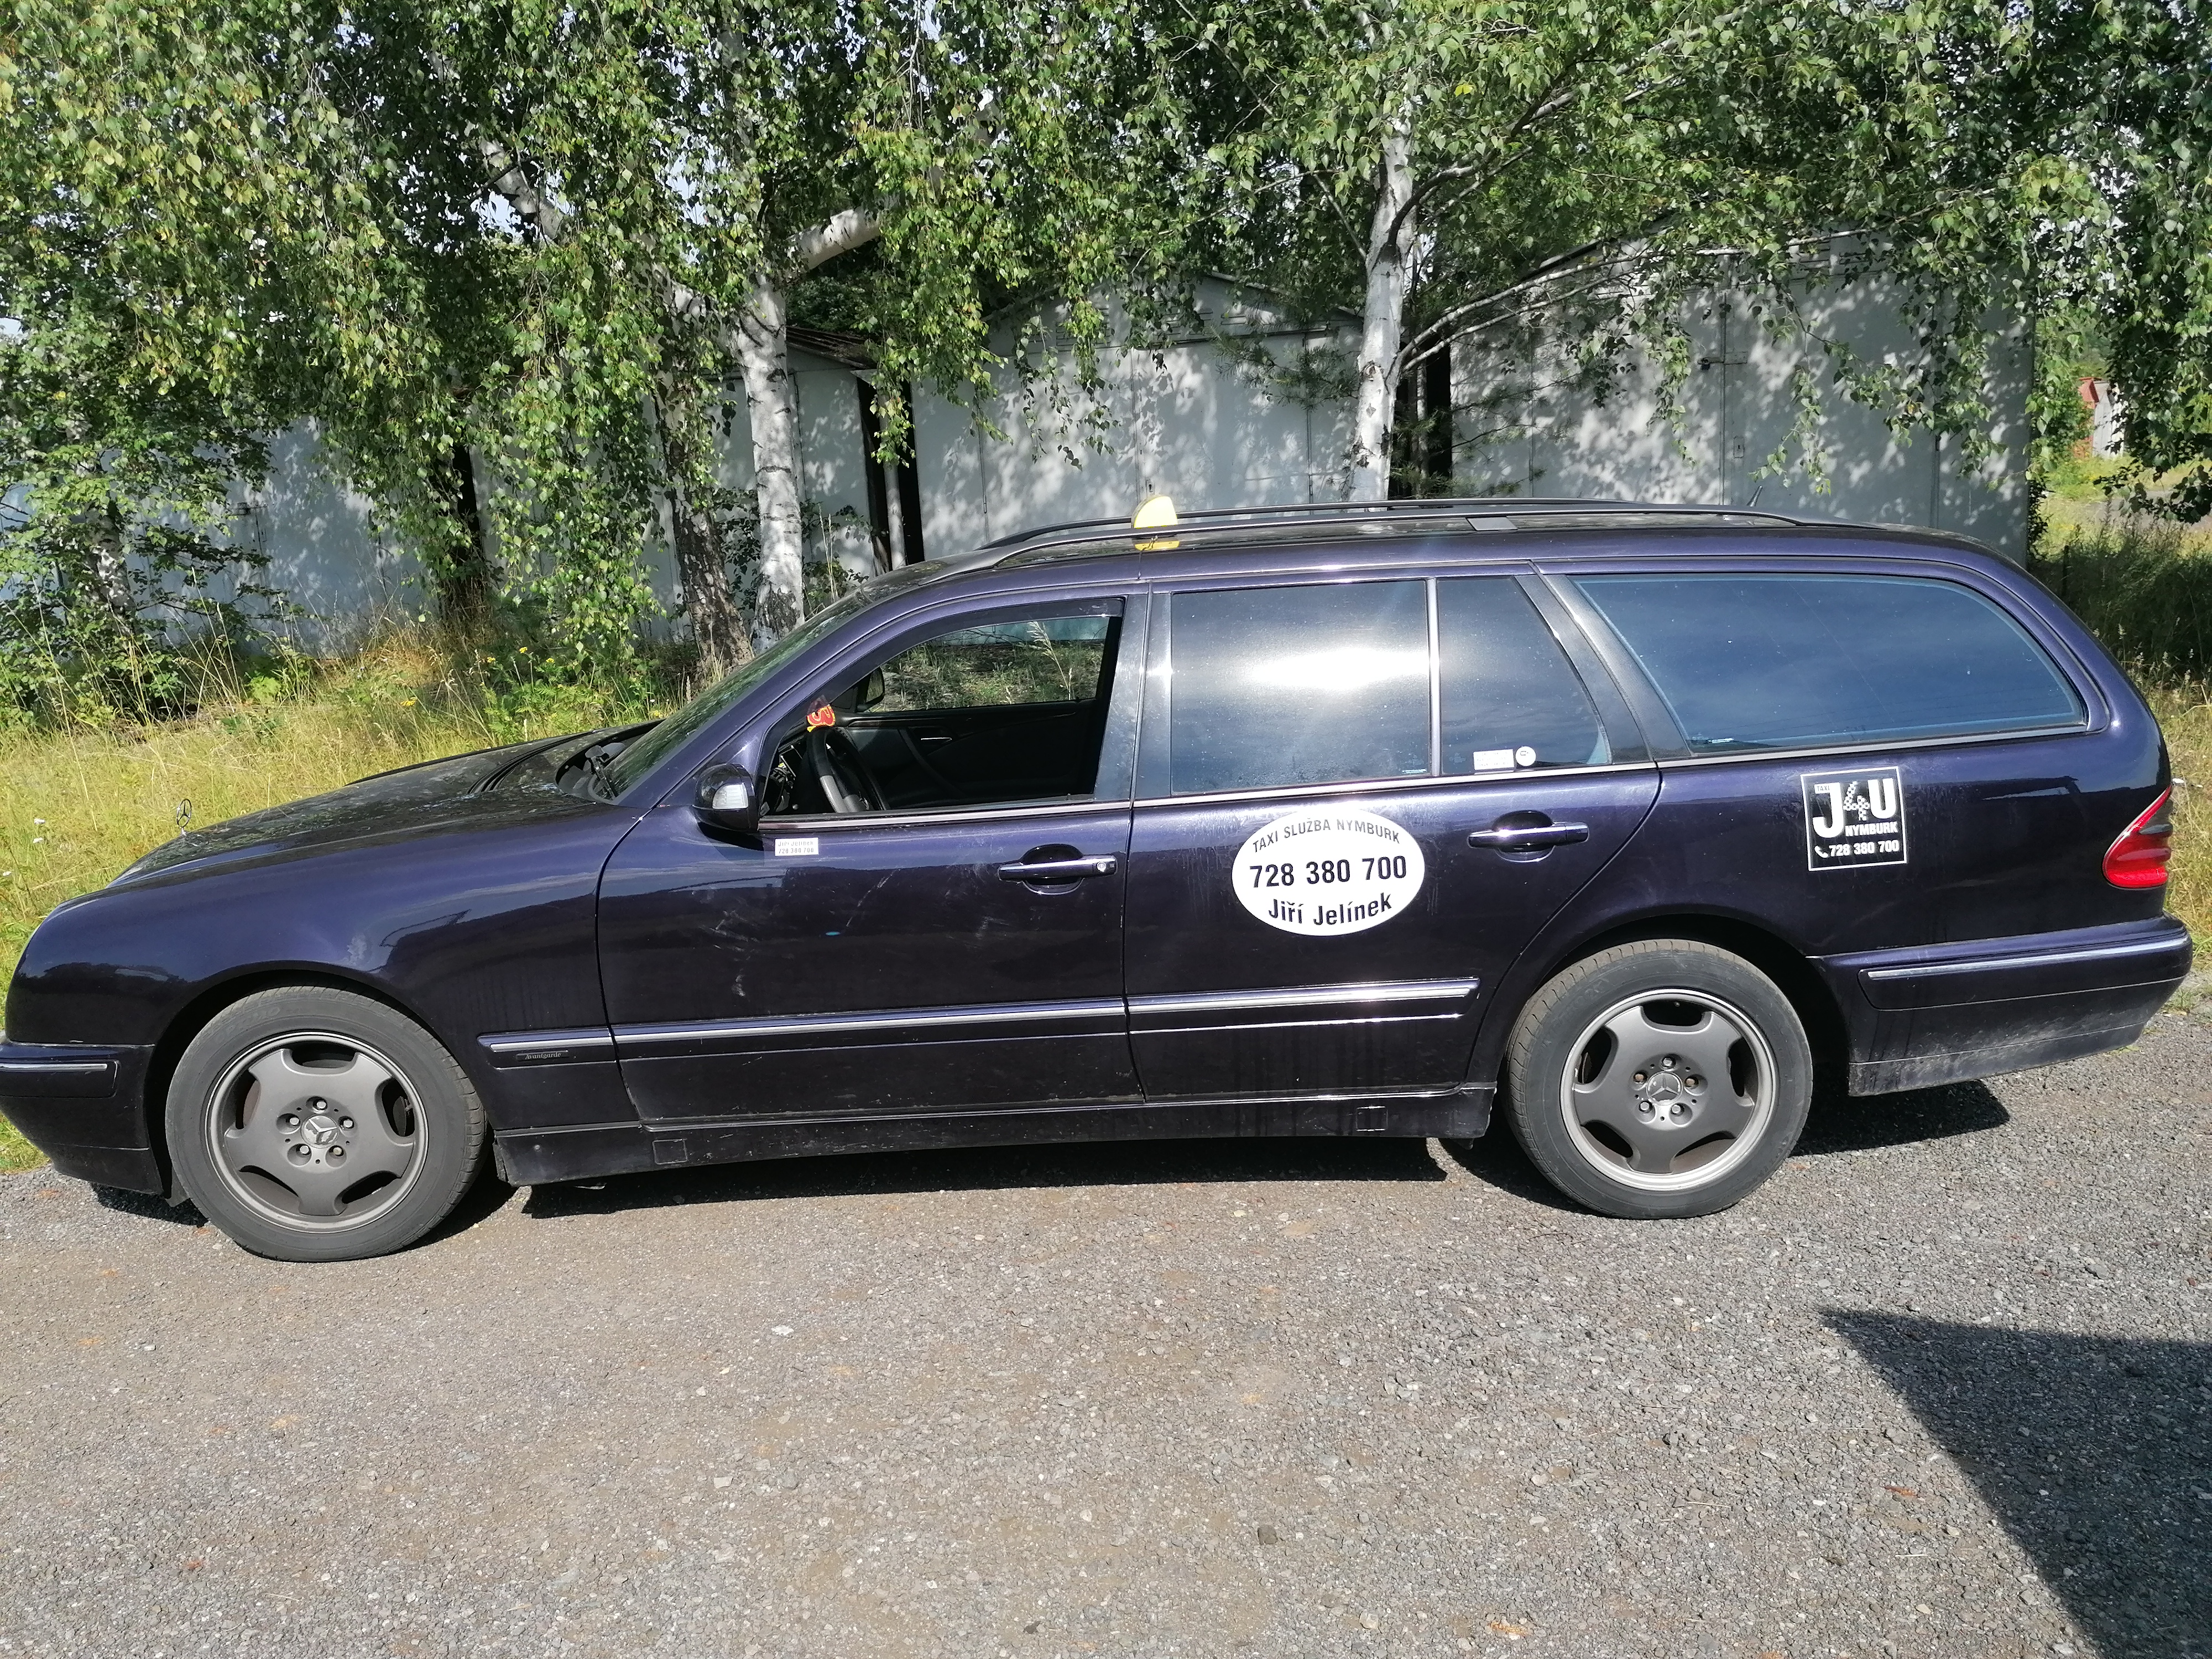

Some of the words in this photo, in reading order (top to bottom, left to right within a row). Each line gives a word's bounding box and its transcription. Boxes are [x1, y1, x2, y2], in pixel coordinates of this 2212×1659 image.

[1253, 831, 1279, 853] TAXI
[1284, 818, 1331, 839] SLUŽBA
[1337, 818, 1400, 844] NYMBURK
[1845, 821, 1898, 837] NYMBURK
[1829, 844, 1850, 857] 728
[1853, 842, 1875, 855] 380
[1878, 839, 1899, 853] 700
[1249, 863, 1295, 888] 728
[1306, 859, 1350, 885] 380
[1361, 855, 1406, 881] 700
[1269, 899, 1305, 924] Jiří
[1313, 892, 1392, 926] Jelínek
[524, 1052, 562, 1060] Avantgarde
